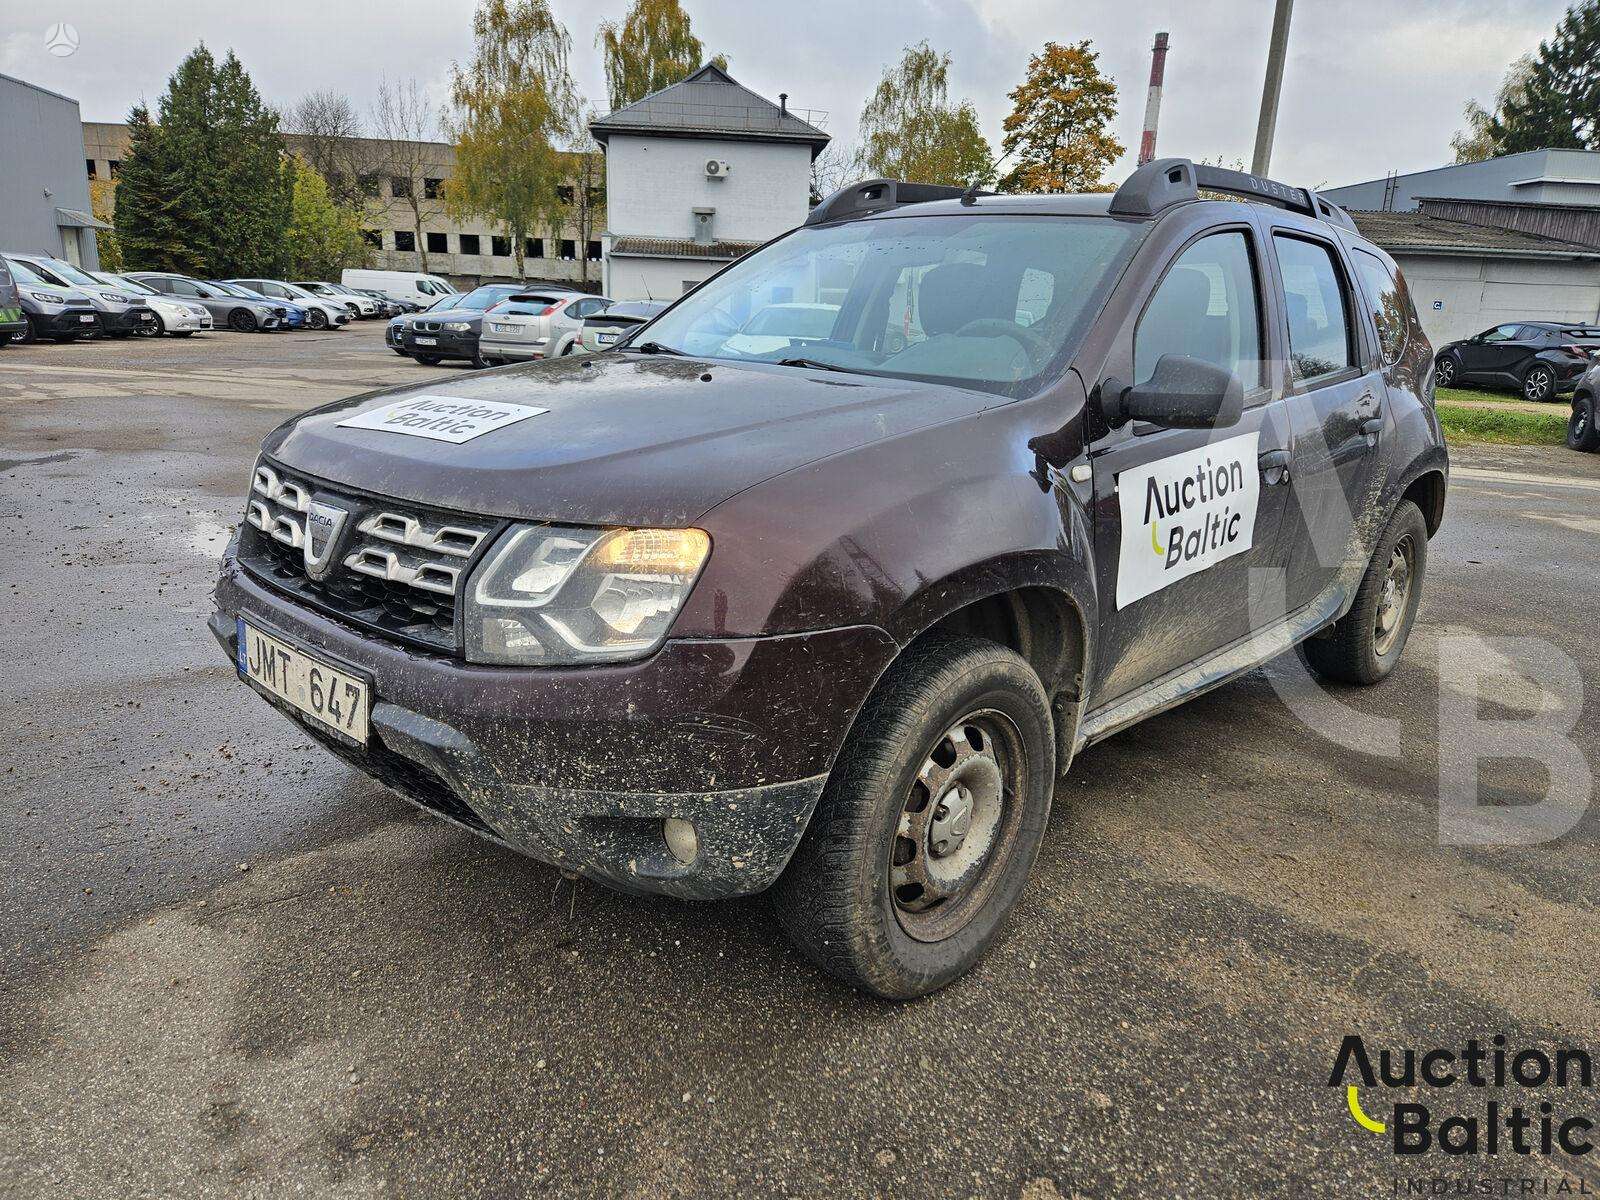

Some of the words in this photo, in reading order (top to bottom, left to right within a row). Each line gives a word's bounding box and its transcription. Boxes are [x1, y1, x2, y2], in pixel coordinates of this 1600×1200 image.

[1250, 177, 1306, 204] DUSTER
[384, 413, 475, 434] Baltic
[400, 399, 510, 421] Auction
[1143, 458, 1243, 525] Auction
[309, 513, 332, 528] DACIA
[1165, 507, 1241, 570] Baltic
[248, 635, 291, 695] JMT
[309, 667, 361, 729] 647
